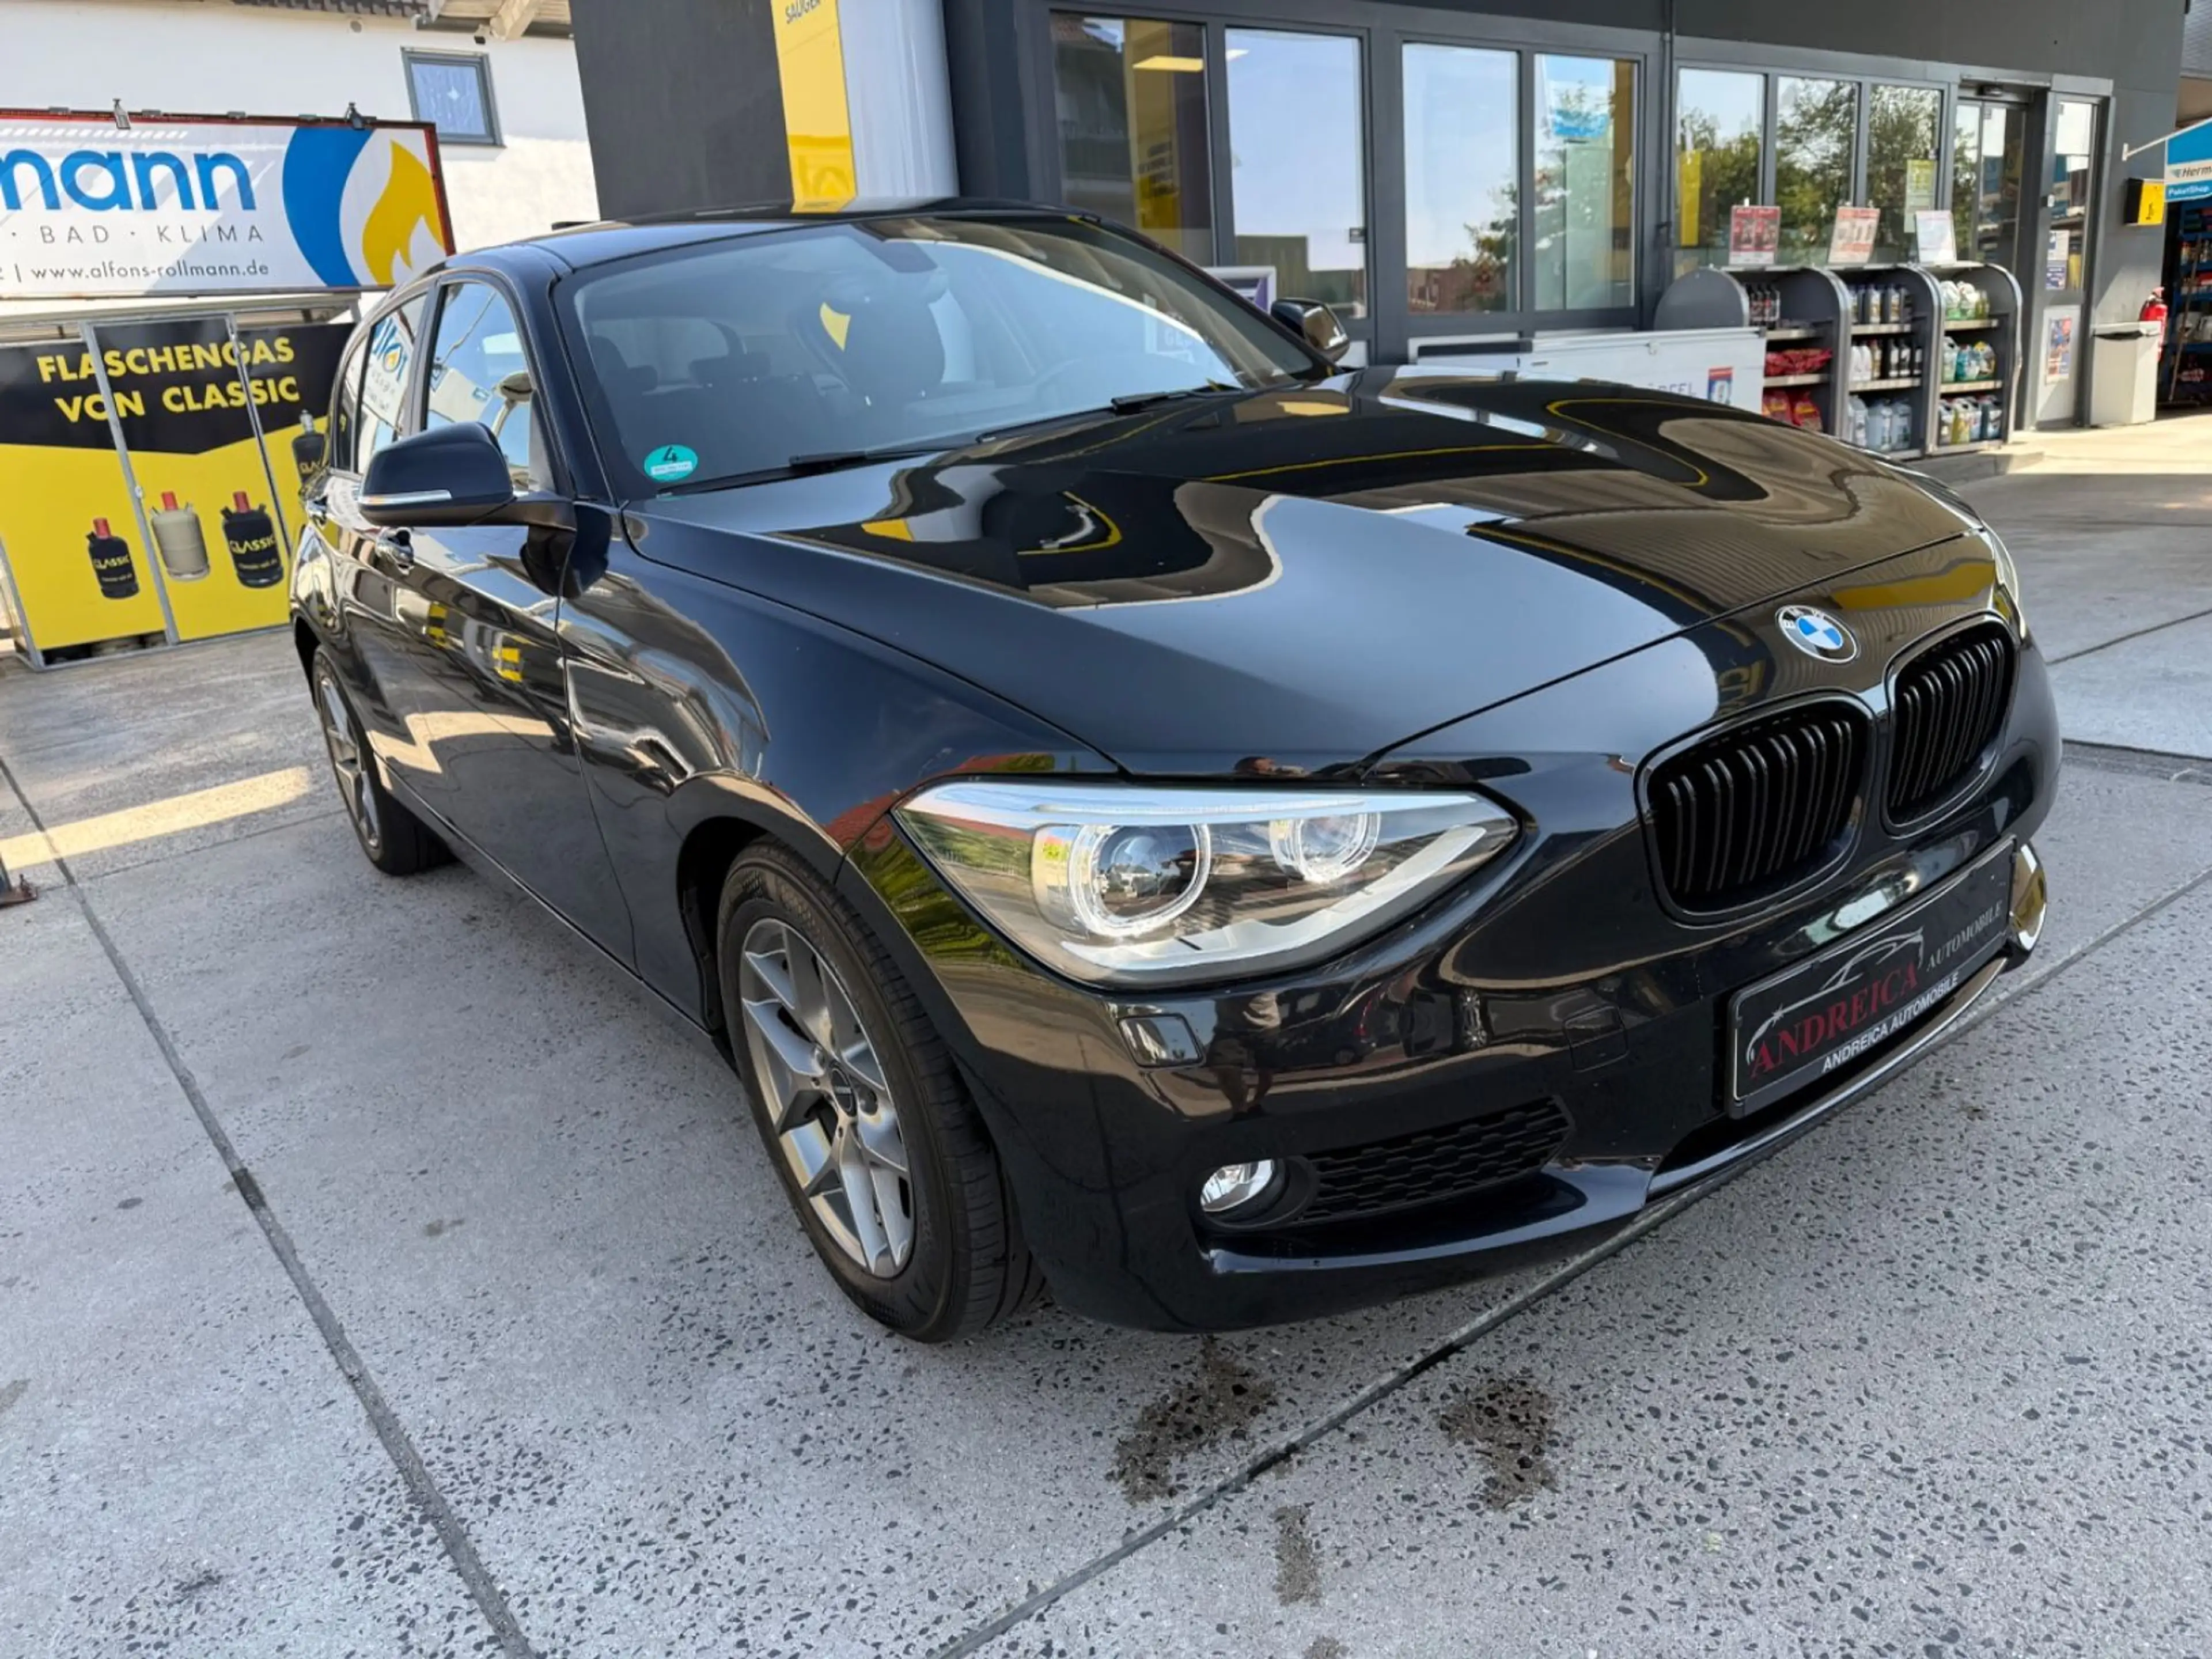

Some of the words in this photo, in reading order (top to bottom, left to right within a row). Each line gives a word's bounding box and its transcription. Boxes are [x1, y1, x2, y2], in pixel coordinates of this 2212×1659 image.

[40, 225, 109, 244] BAD
[156, 224, 264, 243] KLIMA
[31, 258, 269, 279] www.alfons-rollmann.de
[36, 337, 295, 382] FLASCHENGAS
[54, 390, 146, 423] VON
[162, 376, 300, 412] CLASSIC
[662, 446, 679, 463] 4
[1750, 961, 1918, 1080] ANDREICA
[1926, 900, 2003, 972] AUTOMOBILE
[1821, 1022, 1889, 1074] ANDREICA
[1889, 970, 1959, 1032] AUTOMOBILE
